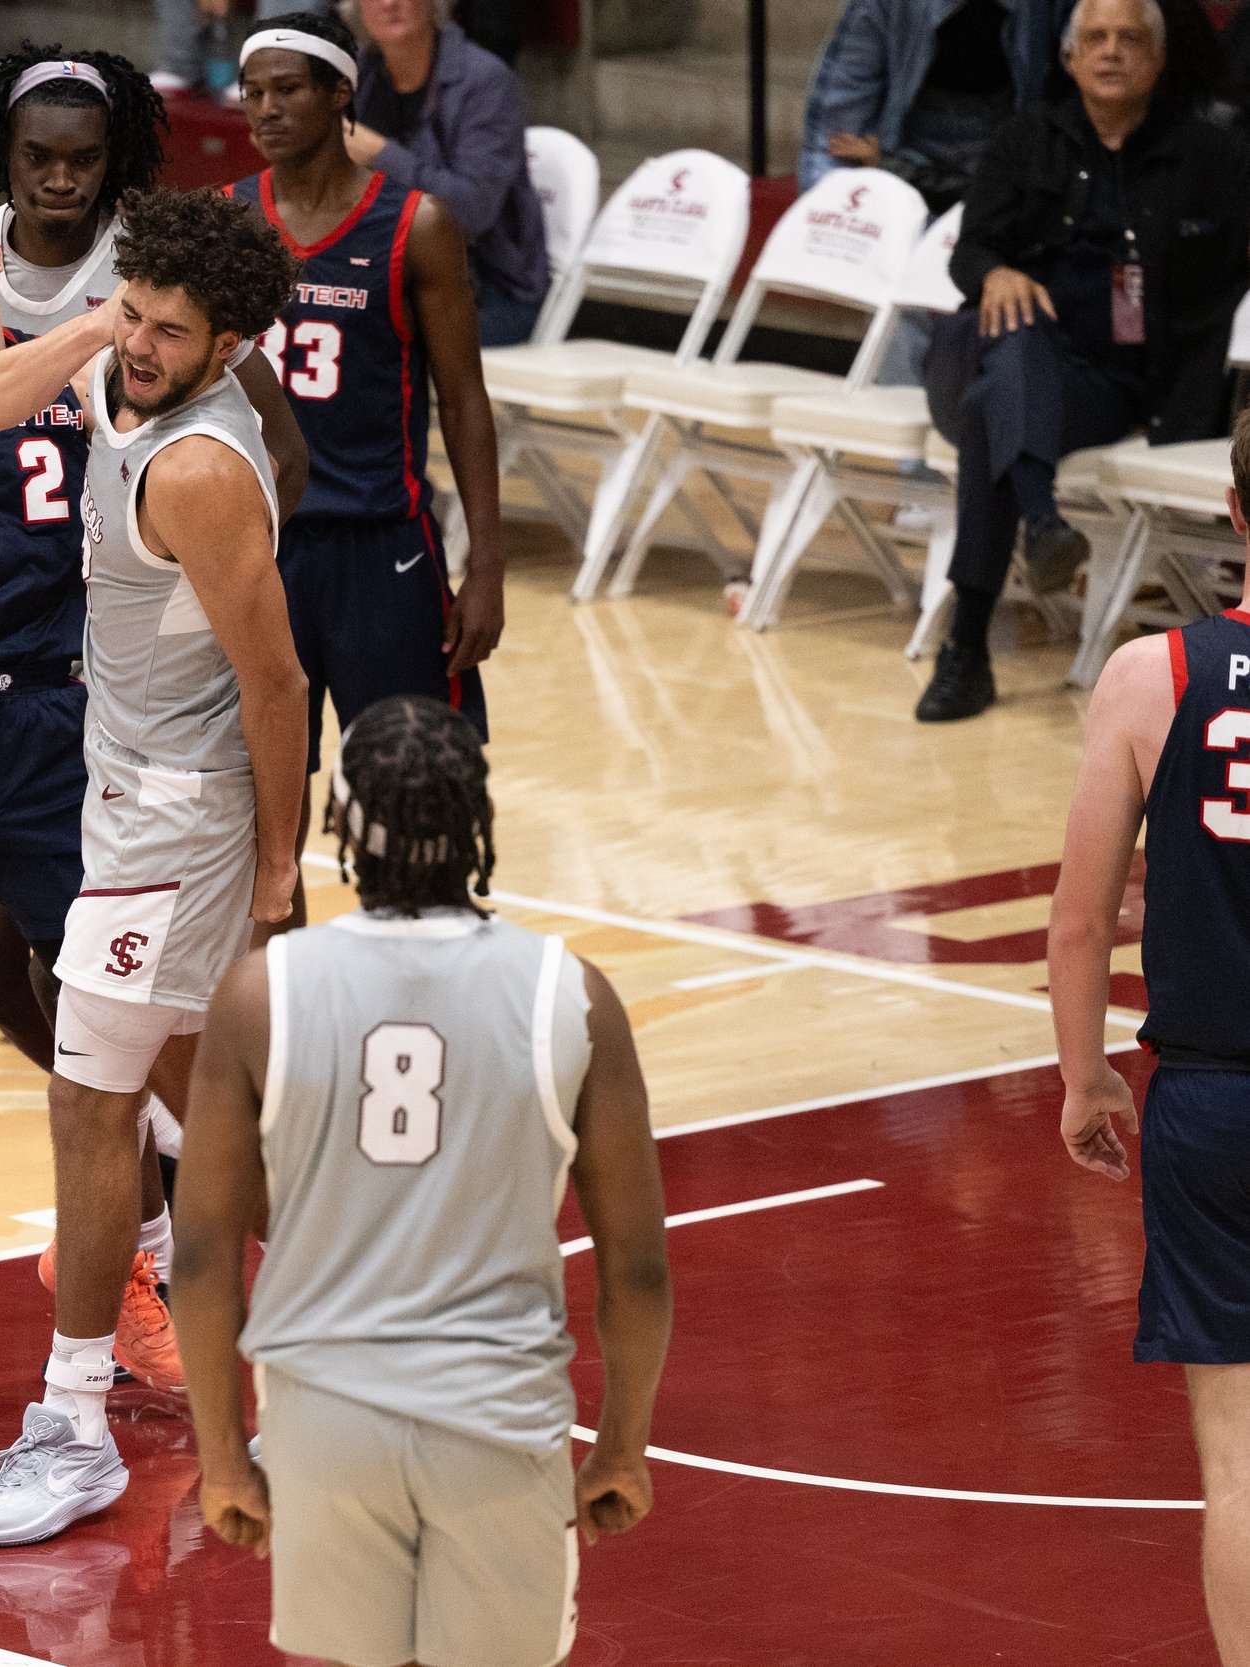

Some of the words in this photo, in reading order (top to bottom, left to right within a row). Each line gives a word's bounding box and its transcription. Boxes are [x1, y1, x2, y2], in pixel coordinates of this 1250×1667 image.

[297, 283, 368, 309] TECH
[16, 436, 70, 525] 2
[356, 1019, 446, 1168] 8
